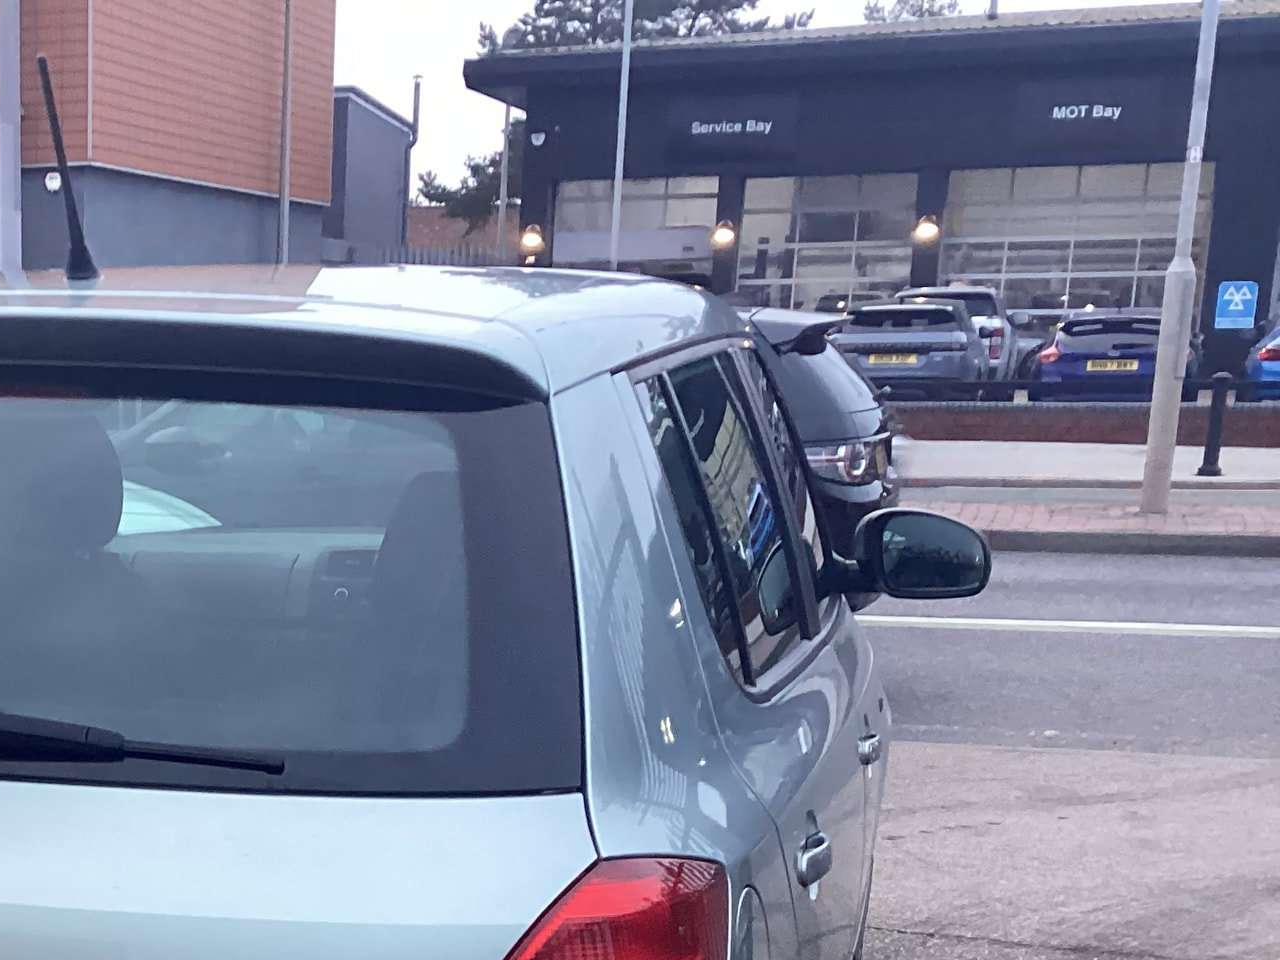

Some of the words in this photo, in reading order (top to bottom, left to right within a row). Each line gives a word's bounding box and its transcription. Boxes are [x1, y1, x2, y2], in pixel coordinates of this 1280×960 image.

[1052, 105, 1089, 119] MOT
[1092, 104, 1122, 120] Bay
[691, 121, 742, 135] Service
[746, 119, 773, 135] Bay
